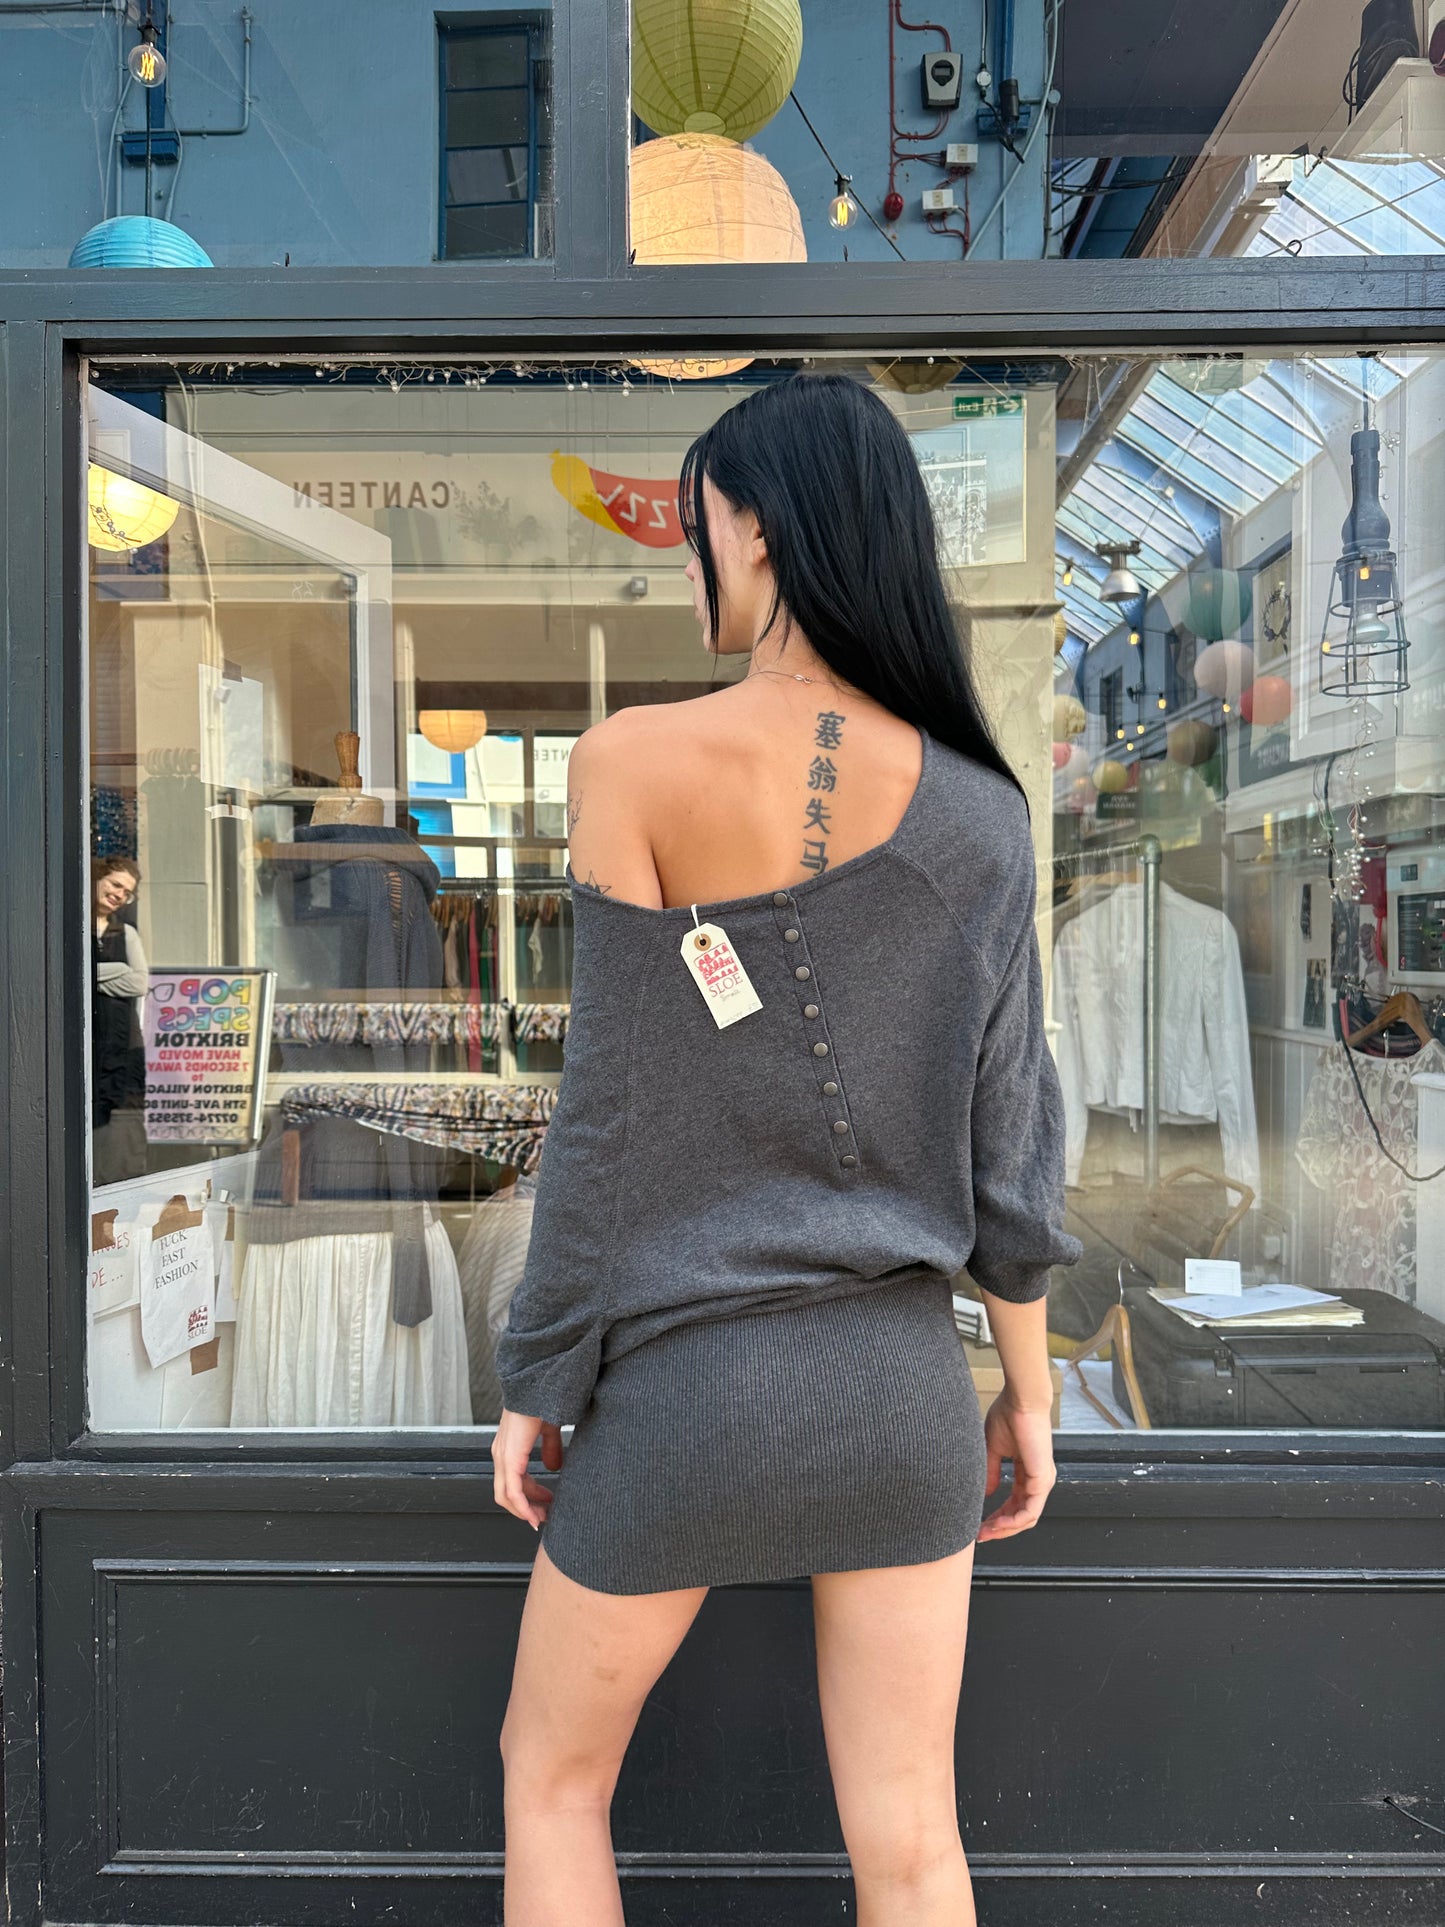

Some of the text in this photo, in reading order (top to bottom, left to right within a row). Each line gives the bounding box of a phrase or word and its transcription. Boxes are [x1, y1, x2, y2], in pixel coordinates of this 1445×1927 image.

[800, 711, 847, 876] 塞翁失马
[708, 972, 744, 998] SLOE
[160, 1230, 188, 1250] FUCK
[162, 1247, 185, 1267] FAST
[154, 1260, 199, 1290] FASHION
